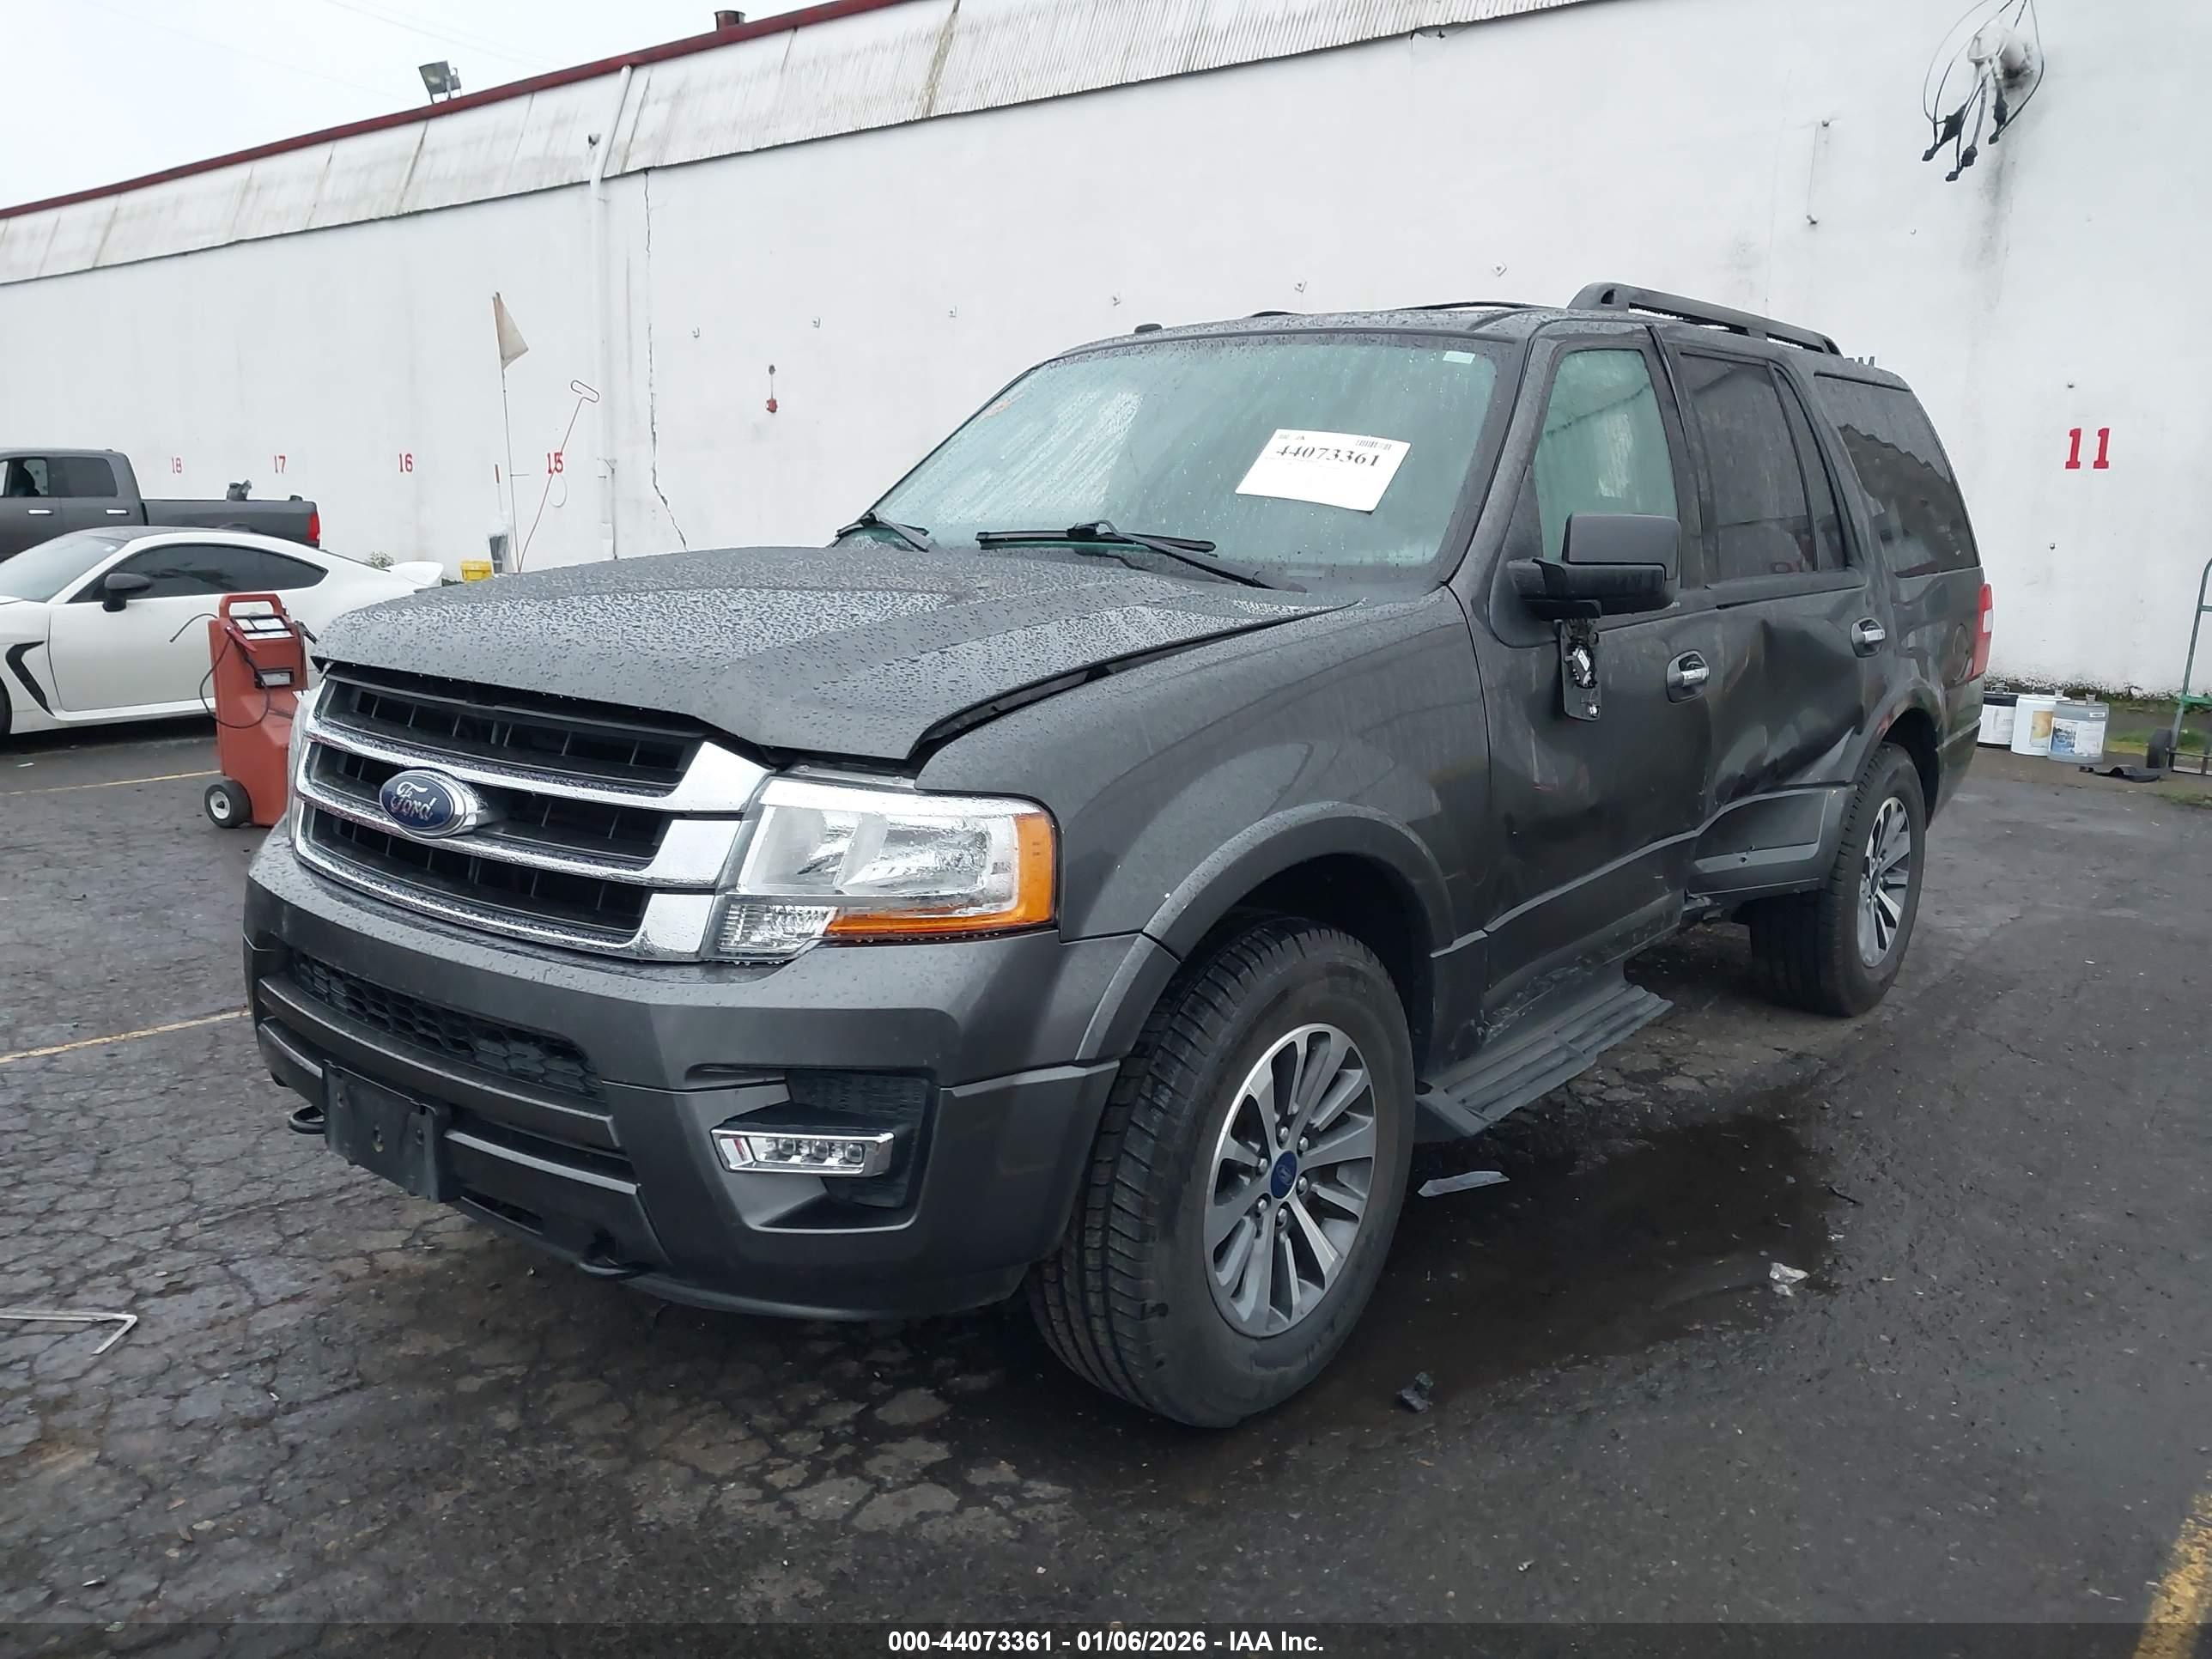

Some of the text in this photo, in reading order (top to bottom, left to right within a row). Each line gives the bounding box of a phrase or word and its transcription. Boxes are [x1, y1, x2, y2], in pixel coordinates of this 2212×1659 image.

[1276, 445, 1380, 466] 44073361
[2064, 428, 2110, 469] 11
[172, 457, 182, 473] 18
[274, 455, 286, 473] 17
[399, 453, 413, 472] 16
[547, 452, 563, 474] 15
[391, 781, 438, 821] Ford
